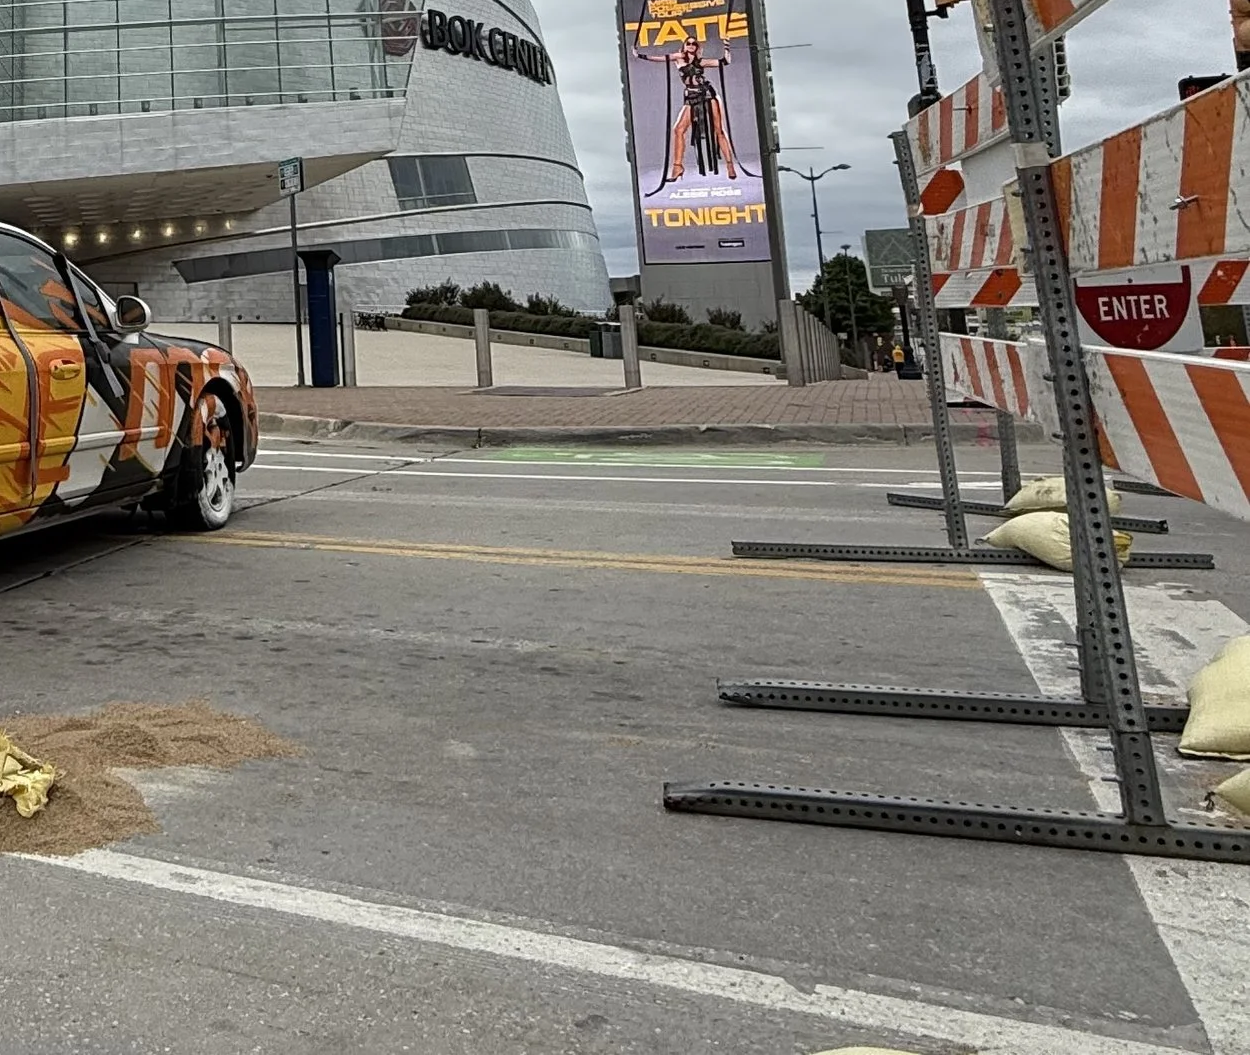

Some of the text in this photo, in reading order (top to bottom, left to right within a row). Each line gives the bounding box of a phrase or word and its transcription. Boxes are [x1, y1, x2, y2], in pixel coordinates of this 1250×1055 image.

[625, 12, 749, 47] TATE
[425, 9, 551, 85] BOK CENTER
[644, 203, 766, 227] TONIGHT
[1097, 294, 1170, 321] ENTER
